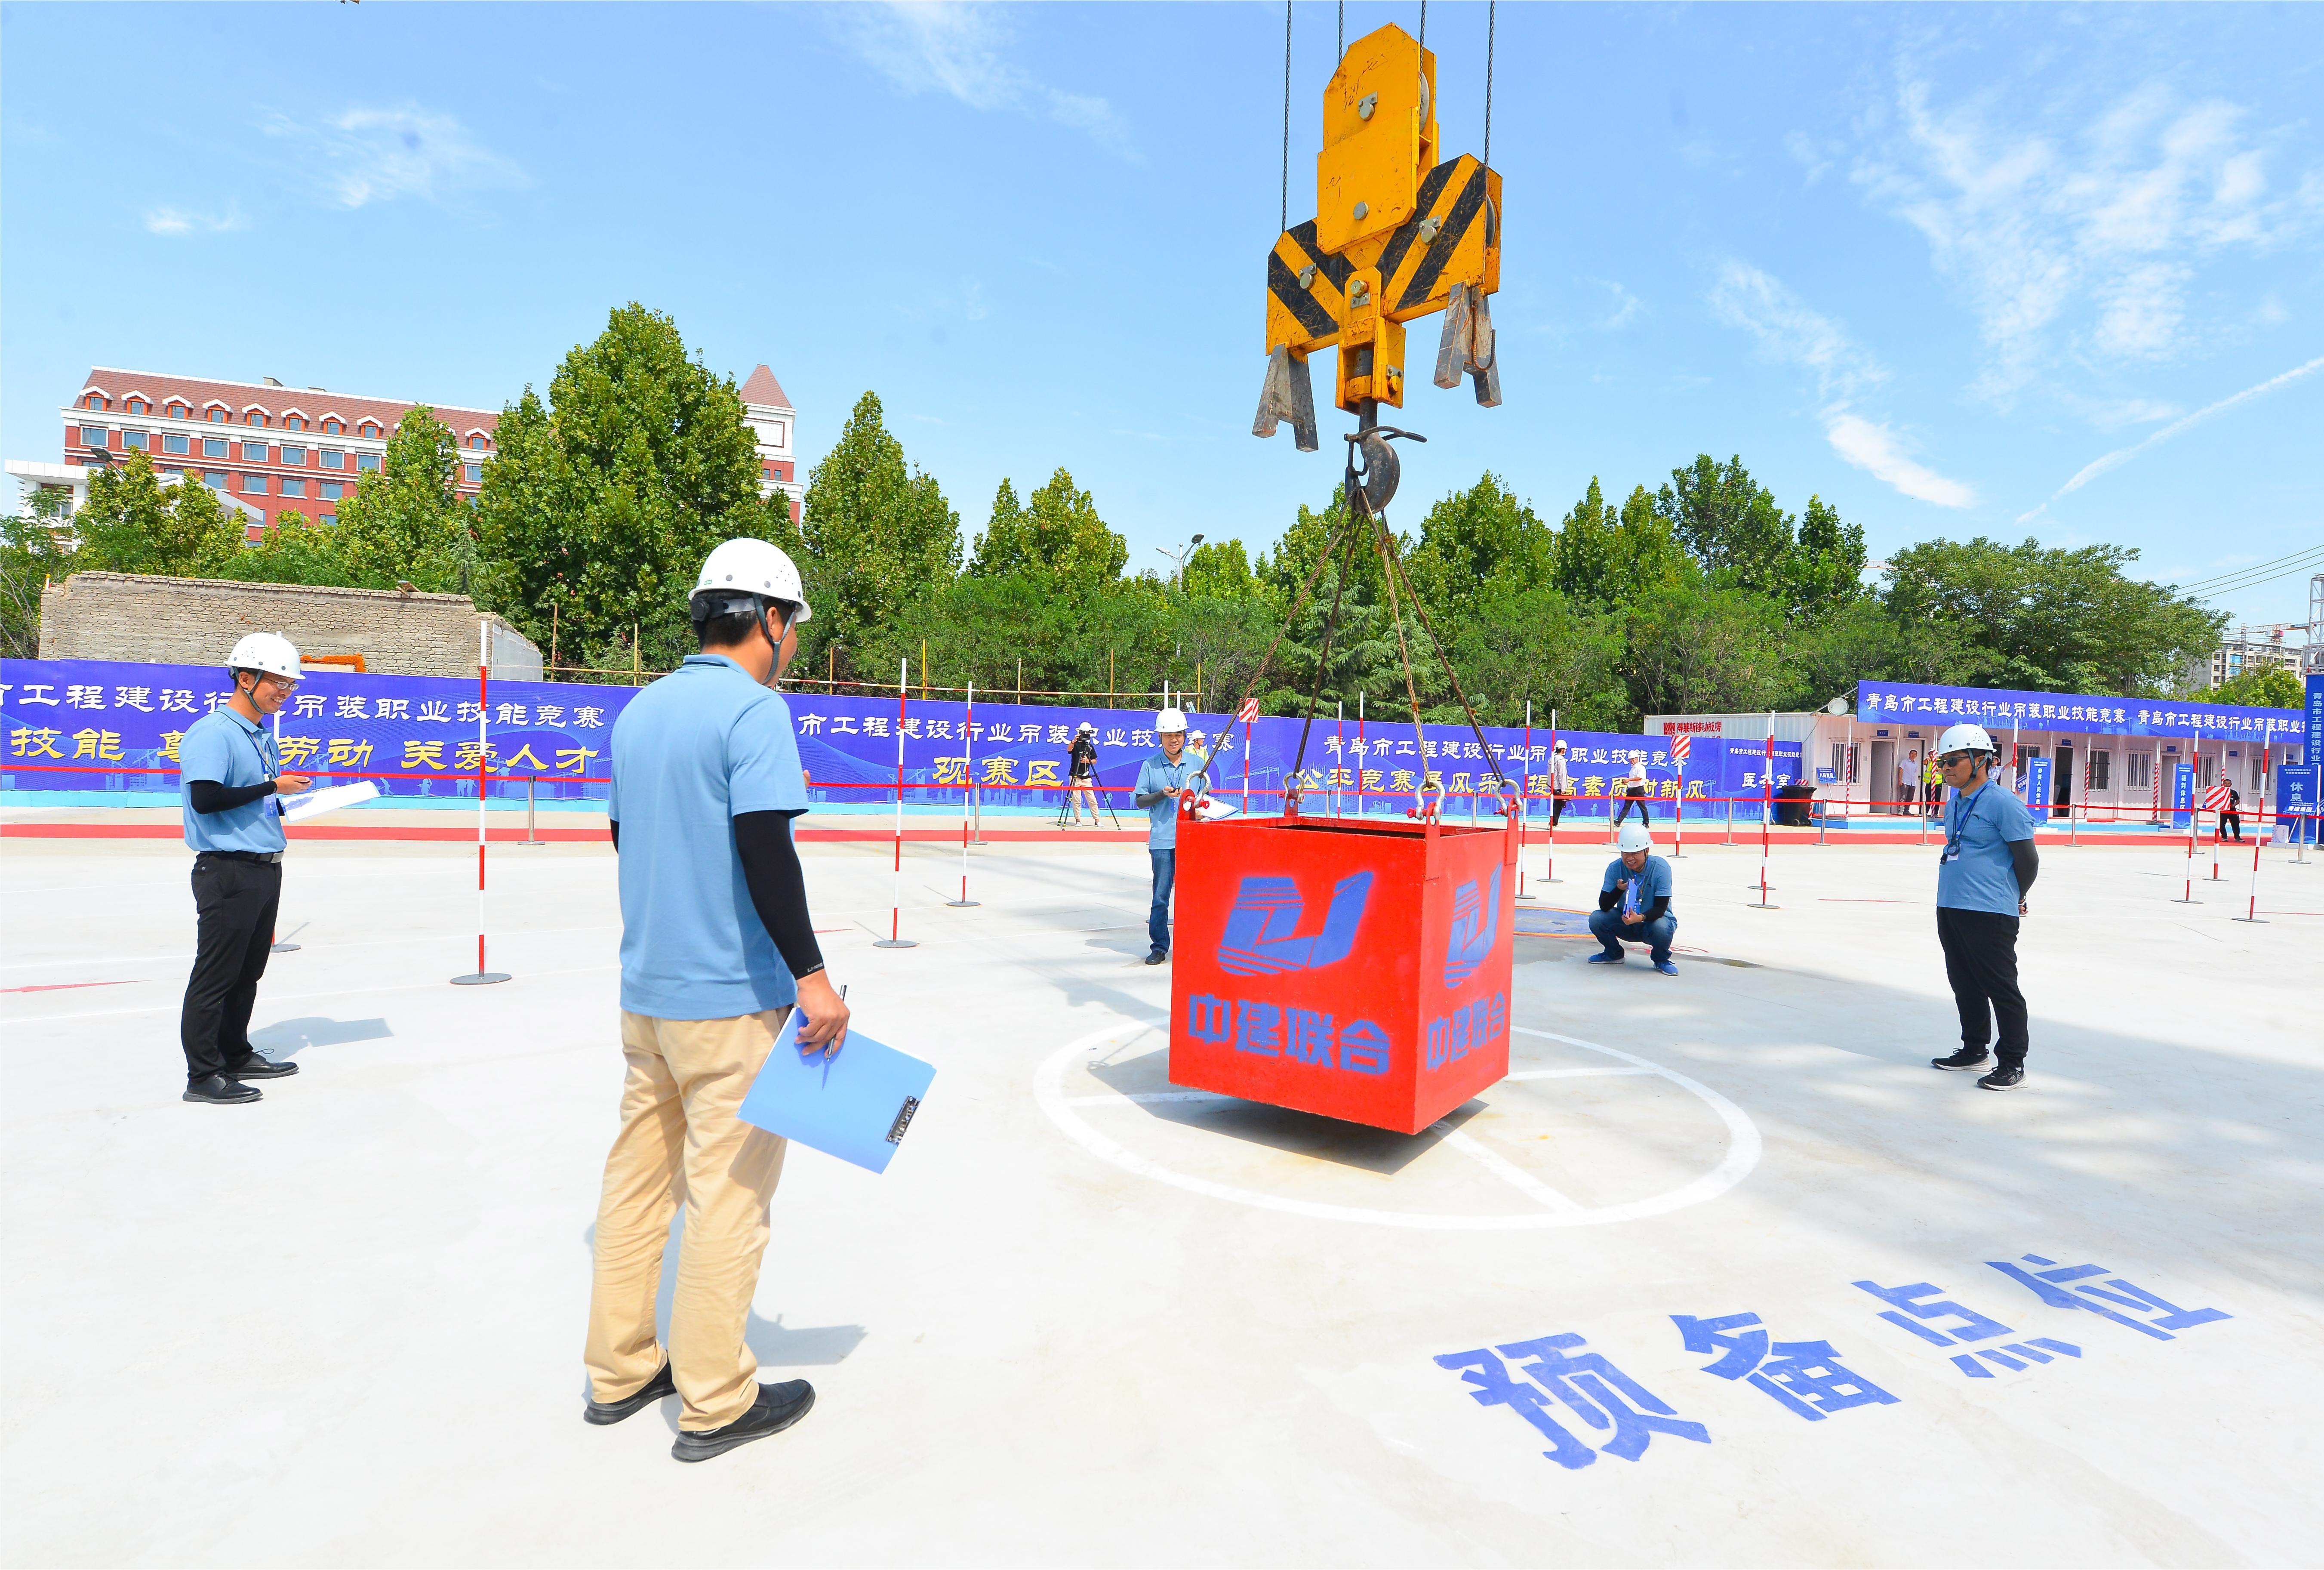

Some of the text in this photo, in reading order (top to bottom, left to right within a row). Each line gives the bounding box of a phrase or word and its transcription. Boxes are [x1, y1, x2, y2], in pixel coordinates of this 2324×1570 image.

[0, 683, 605, 729] 工程建设行吊装职业技能竞赛
[1866, 692, 2125, 724] 青岛市工程建设行业吊装职业技能竞赛
[11, 727, 599, 774] 技能 尊劳动 关爱人才
[932, 756, 1064, 787] 观赛区
[1324, 735, 1688, 767] 青岛市工程建设行业吊职业技能竞
[1188, 992, 1391, 1076] 中建联合
[1426, 992, 1505, 1072] 中建联合
[1432, 1252, 2235, 1471] 预备点位
